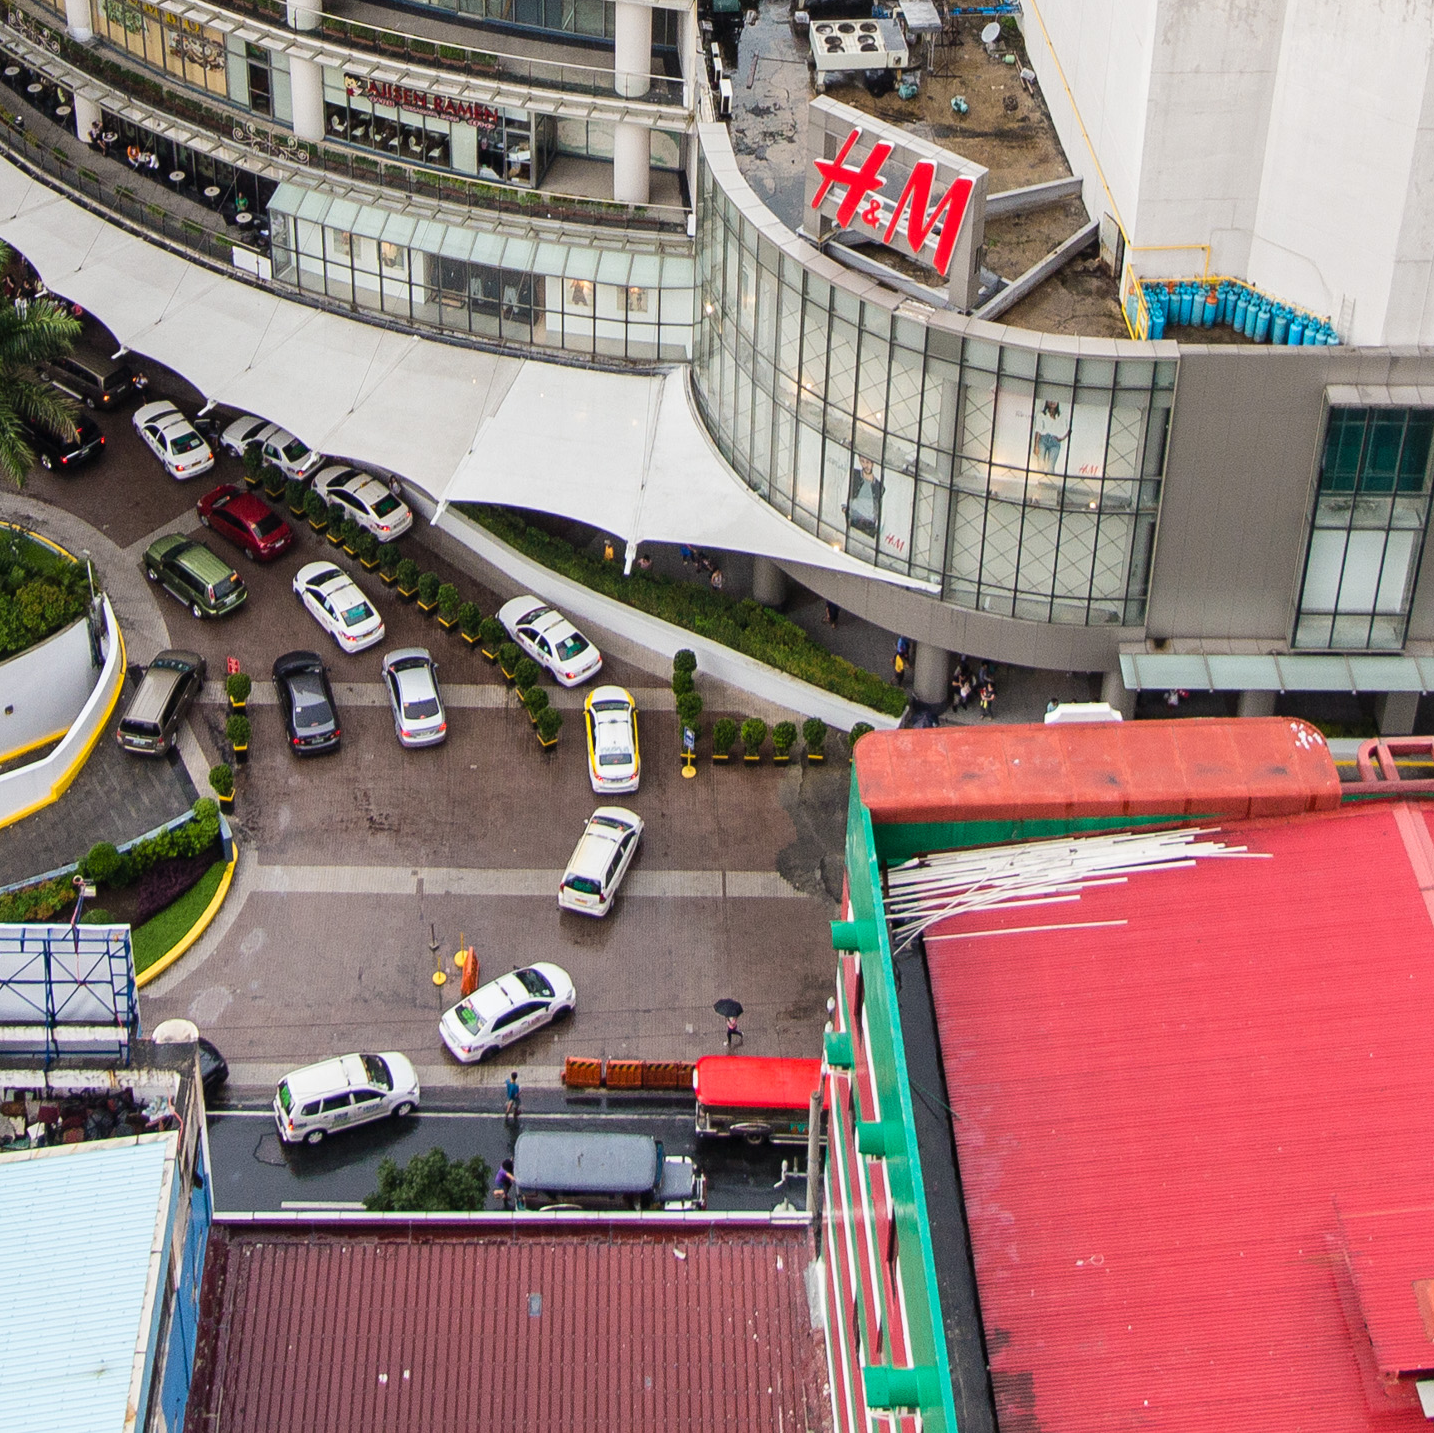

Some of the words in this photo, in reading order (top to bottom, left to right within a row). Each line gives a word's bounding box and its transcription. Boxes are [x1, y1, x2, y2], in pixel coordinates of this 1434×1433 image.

[367, 80, 428, 107] AJISEN
[432, 94, 499, 125] RAMEN
[811, 126, 977, 278] H&M
